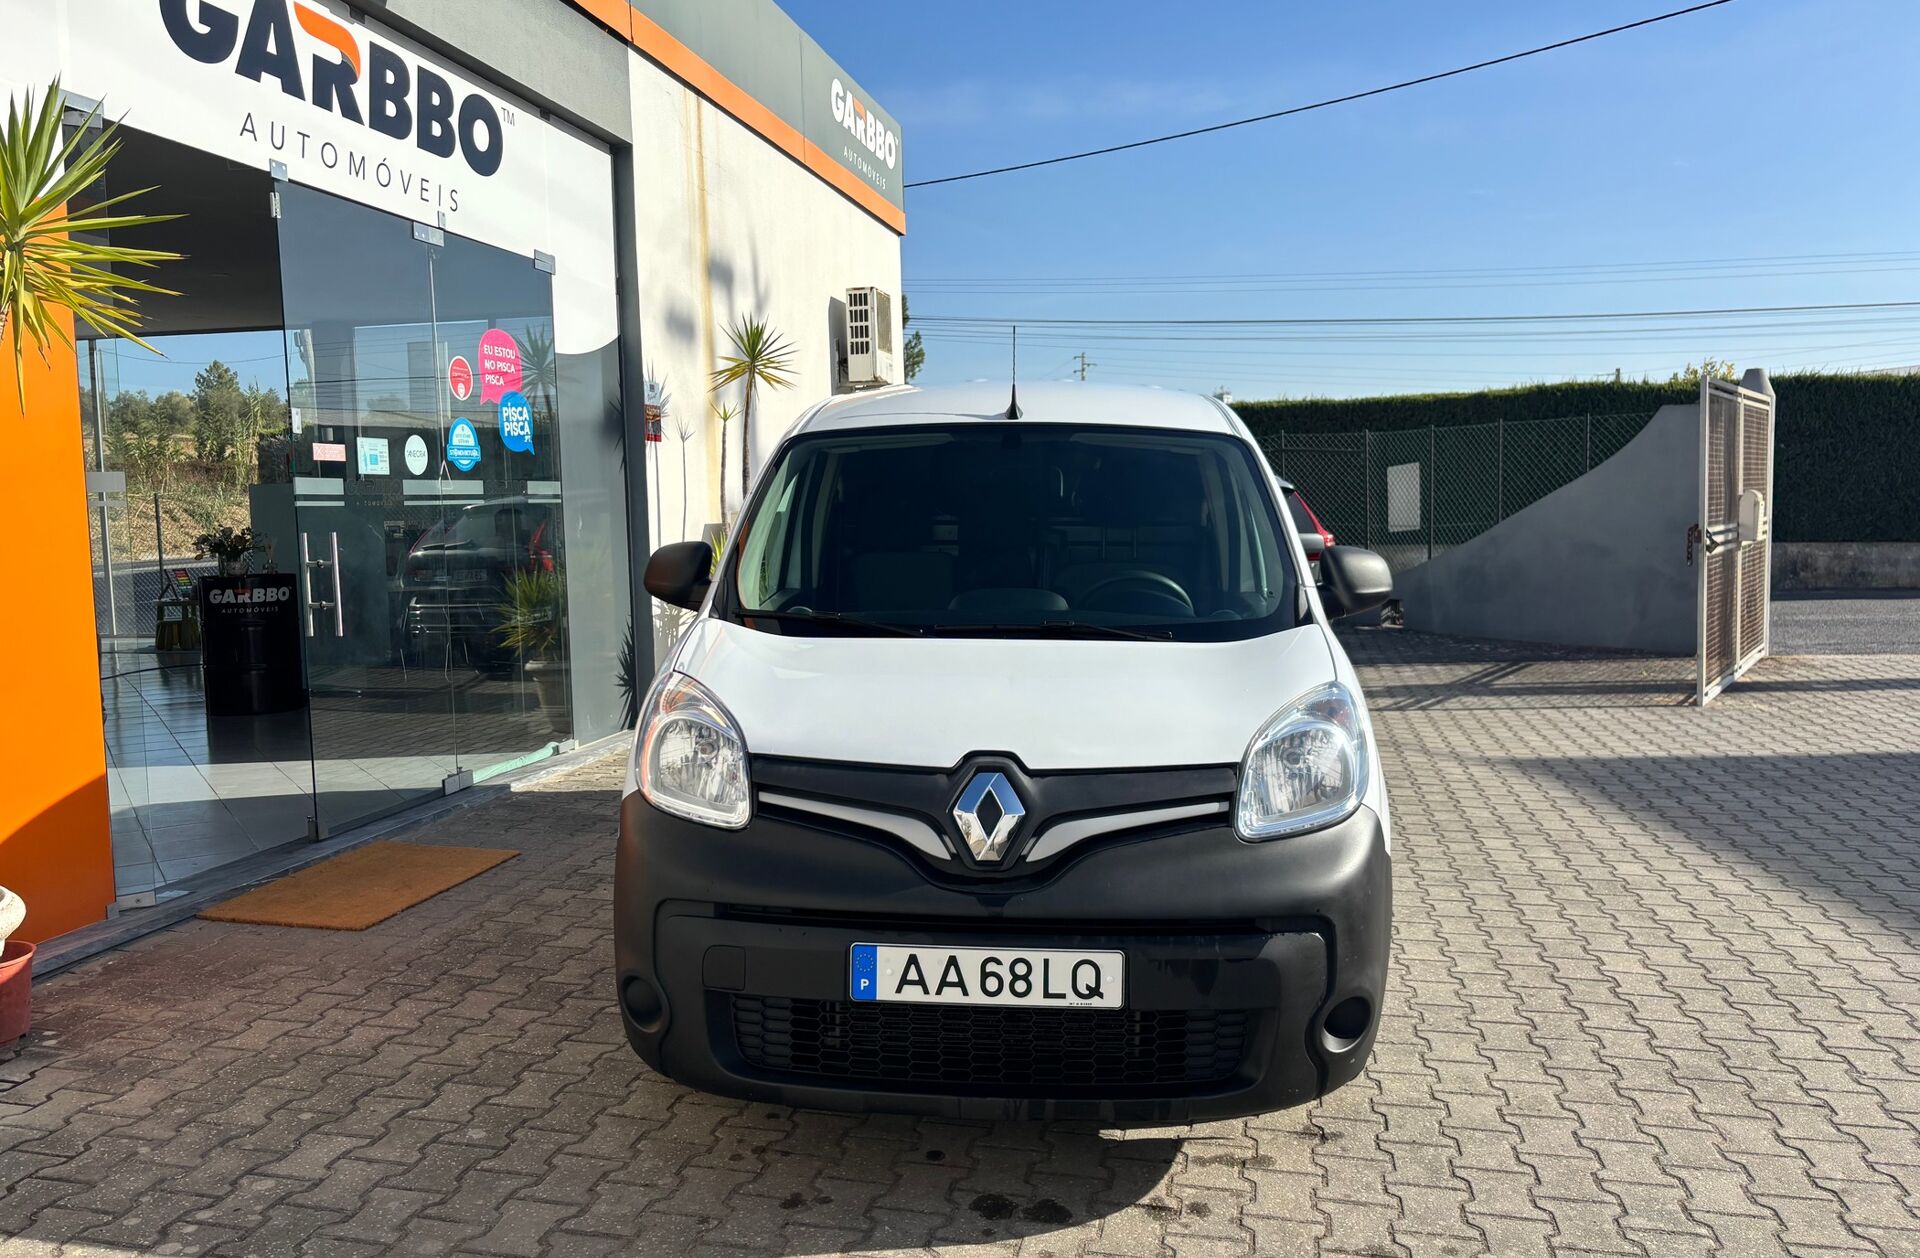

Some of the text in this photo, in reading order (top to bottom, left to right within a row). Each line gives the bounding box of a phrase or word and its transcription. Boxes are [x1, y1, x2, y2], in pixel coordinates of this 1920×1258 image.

[159, 0, 504, 178] GARBBO
[831, 78, 896, 170] GARBBO
[239, 112, 459, 212] AUTOMÓVEIS
[484, 344, 516, 360] EU ESTOU
[484, 359, 516, 374] NO PISCA
[485, 374, 505, 386] PISCA
[504, 421, 531, 437] PISCA
[209, 586, 290, 604] GARBBO
[860, 979, 870, 991] P
